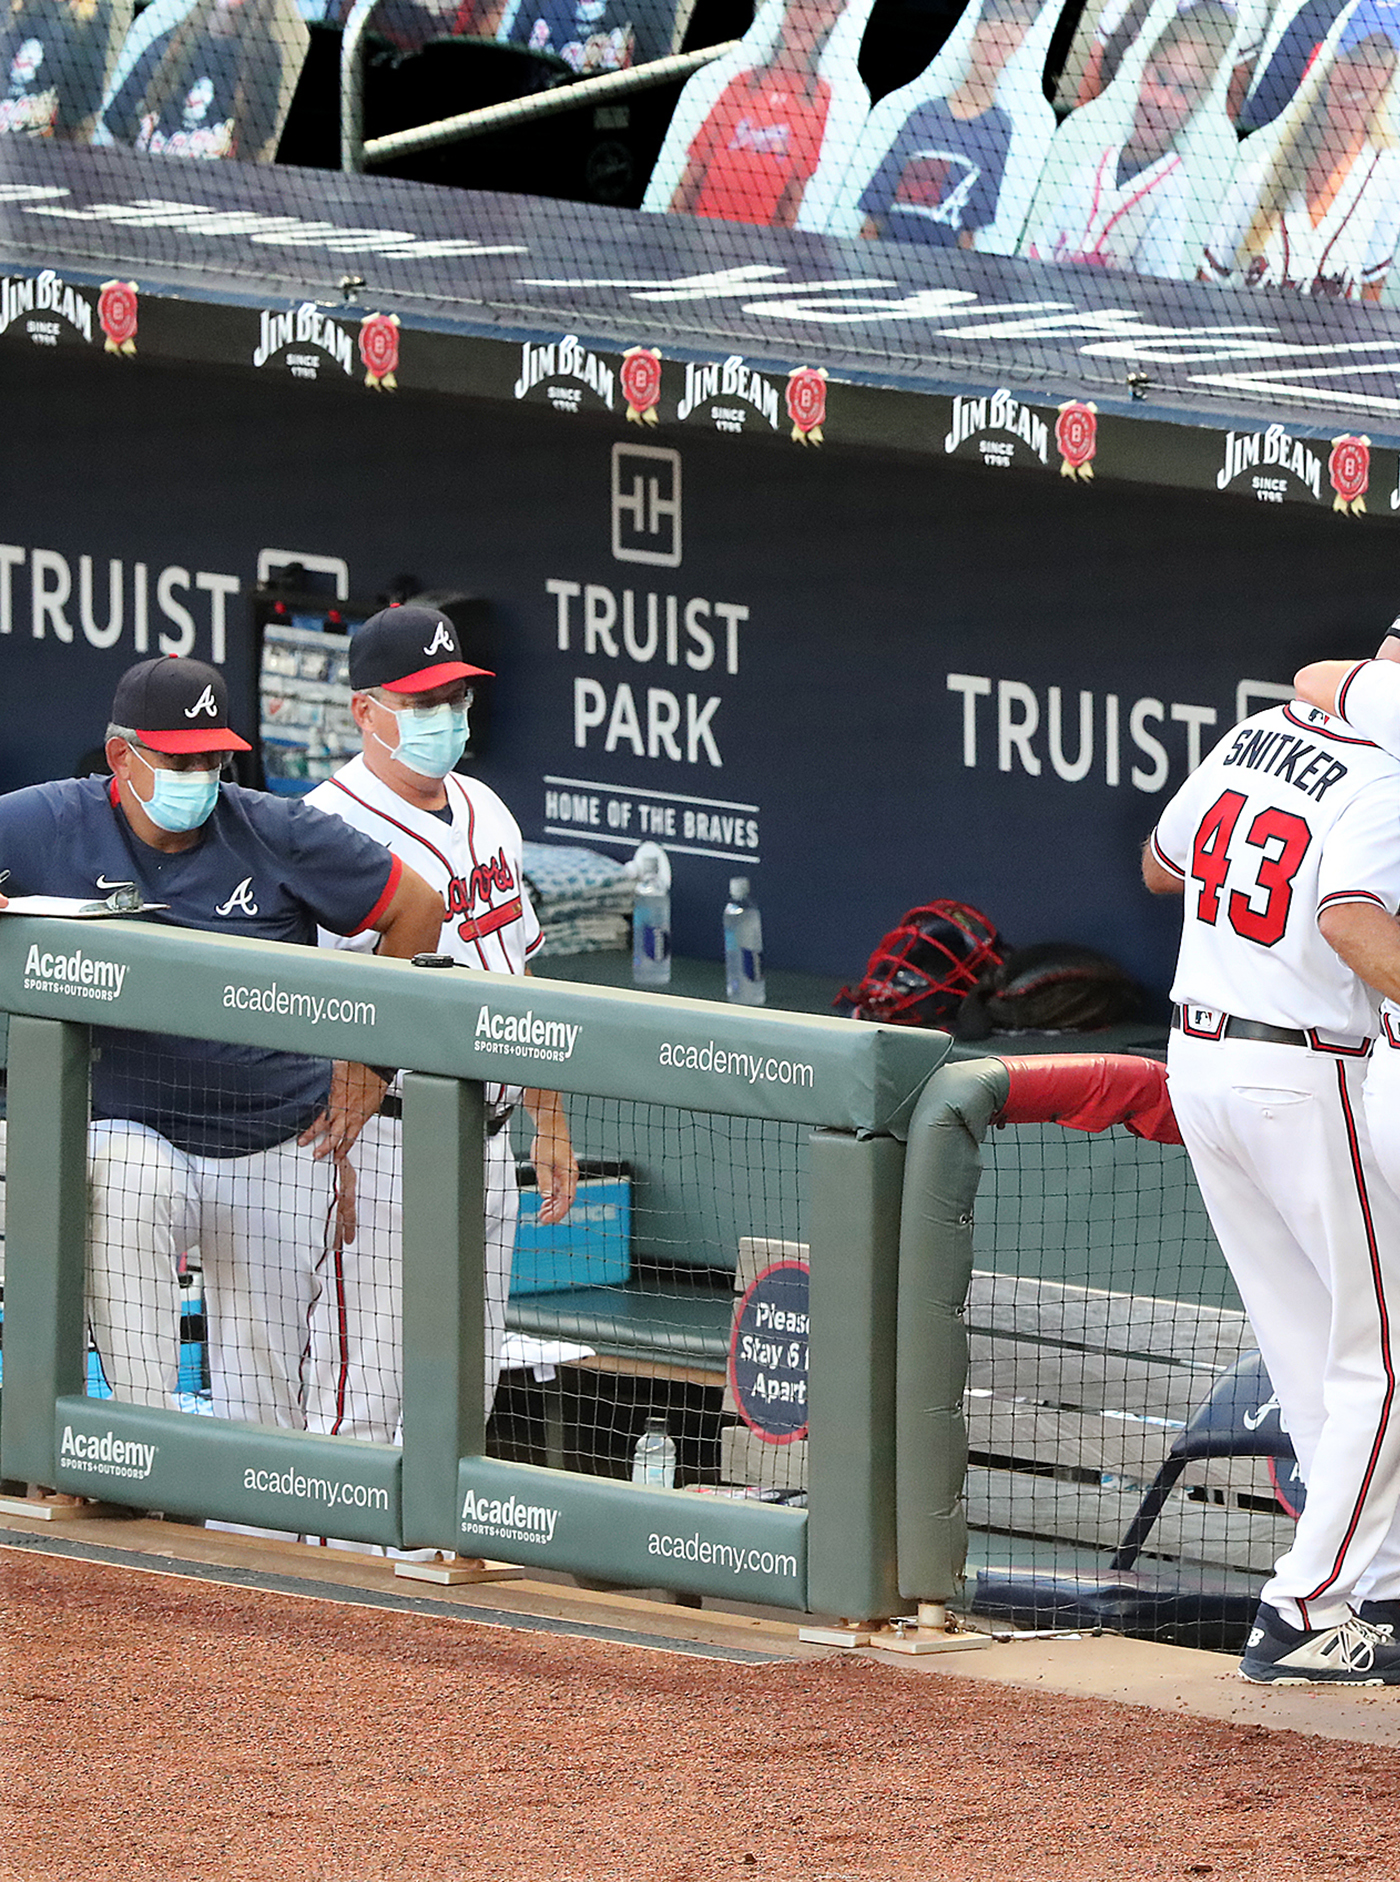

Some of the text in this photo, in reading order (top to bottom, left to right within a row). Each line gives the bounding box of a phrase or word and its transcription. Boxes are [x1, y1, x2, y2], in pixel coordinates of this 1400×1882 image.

[0, 270, 93, 343] JIM BEAM
[27, 320, 61, 336] SINCE
[253, 302, 354, 376] JIM BEAM
[514, 335, 614, 411] JIM BEAM
[677, 355, 779, 430] JIM BEAM
[711, 406, 746, 422] SINCE
[945, 388, 1049, 465] JIM BEAM
[979, 440, 1015, 456] SINCE
[1216, 423, 1321, 500] JIM BEAM
[1252, 476, 1287, 492] SINCE
[0, 543, 240, 664] TRUIST
[546, 578, 750, 675] TRUIST
[574, 677, 723, 768] PARK
[946, 673, 1217, 794] TRUIST
[1223, 729, 1348, 802] SNITKER
[545, 791, 760, 849] HOME OF THE BRAVES
[1191, 788, 1313, 948] 43
[24, 943, 127, 998] Academy
[24, 978, 113, 1001] SPORTS+OUTDOORS
[222, 982, 376, 1026] academy.com
[474, 1040, 566, 1062] SPORTS+OUTDOORS
[475, 1005, 579, 1058] Academy
[659, 1040, 814, 1088] academy.com
[755, 1302, 811, 1335] Pleas
[740, 1335, 783, 1370] Stay
[787, 1342, 800, 1369] 6
[751, 1372, 807, 1405] Apart
[60, 1425, 156, 1477] Academy
[60, 1457, 145, 1480] SPORTS+OUTDOORS
[243, 1467, 389, 1510] academy.com
[461, 1522, 548, 1545] SPORTS+OUTDOORS
[462, 1489, 557, 1541] Academy
[648, 1532, 797, 1577] academy.com
